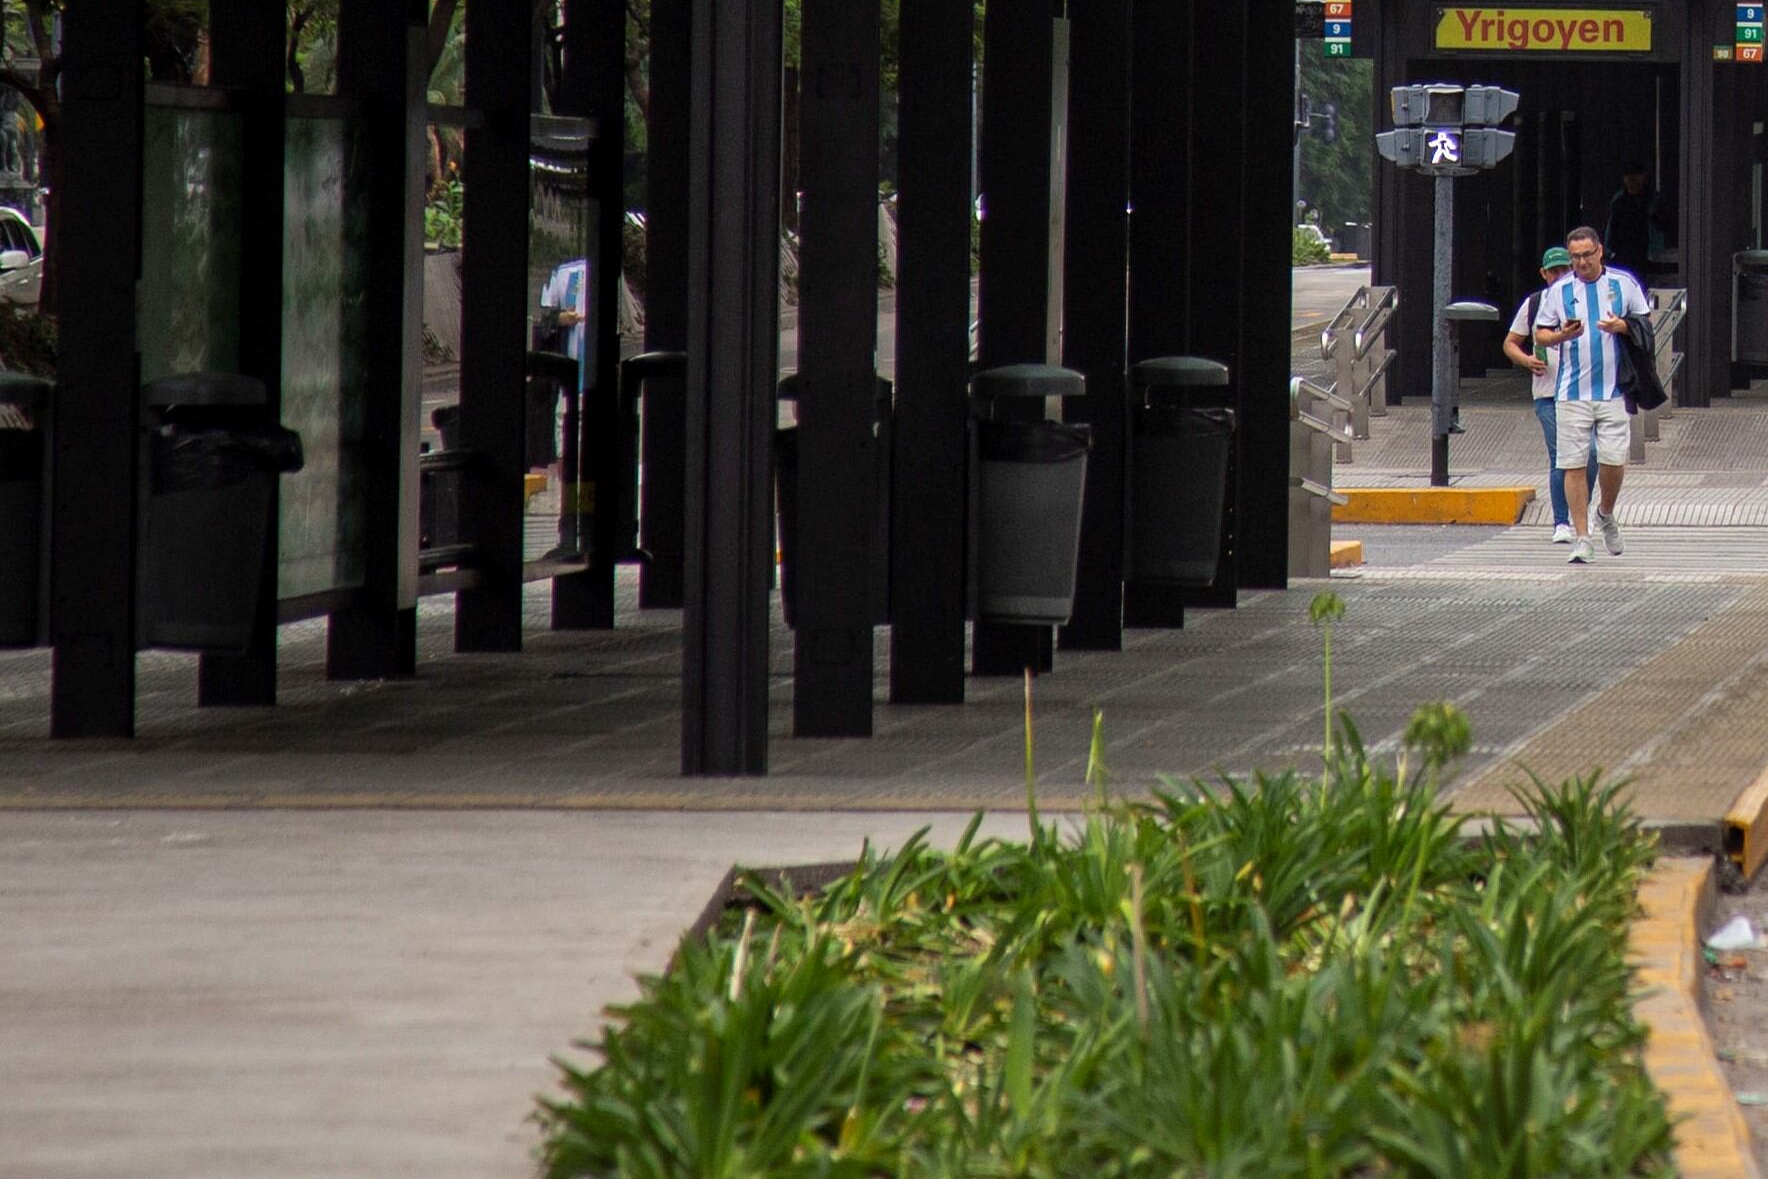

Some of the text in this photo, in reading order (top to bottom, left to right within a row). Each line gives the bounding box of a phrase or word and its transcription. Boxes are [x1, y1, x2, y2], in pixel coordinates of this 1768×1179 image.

[1329, 3, 1344, 15] 67
[1746, 8, 1755, 19] 9
[1332, 23, 1341, 35] 9
[1455, 10, 1625, 49] Yrigoyen
[1744, 28, 1757, 39] 91
[1330, 43, 1343, 55] 91
[1743, 48, 1758, 60] 67
